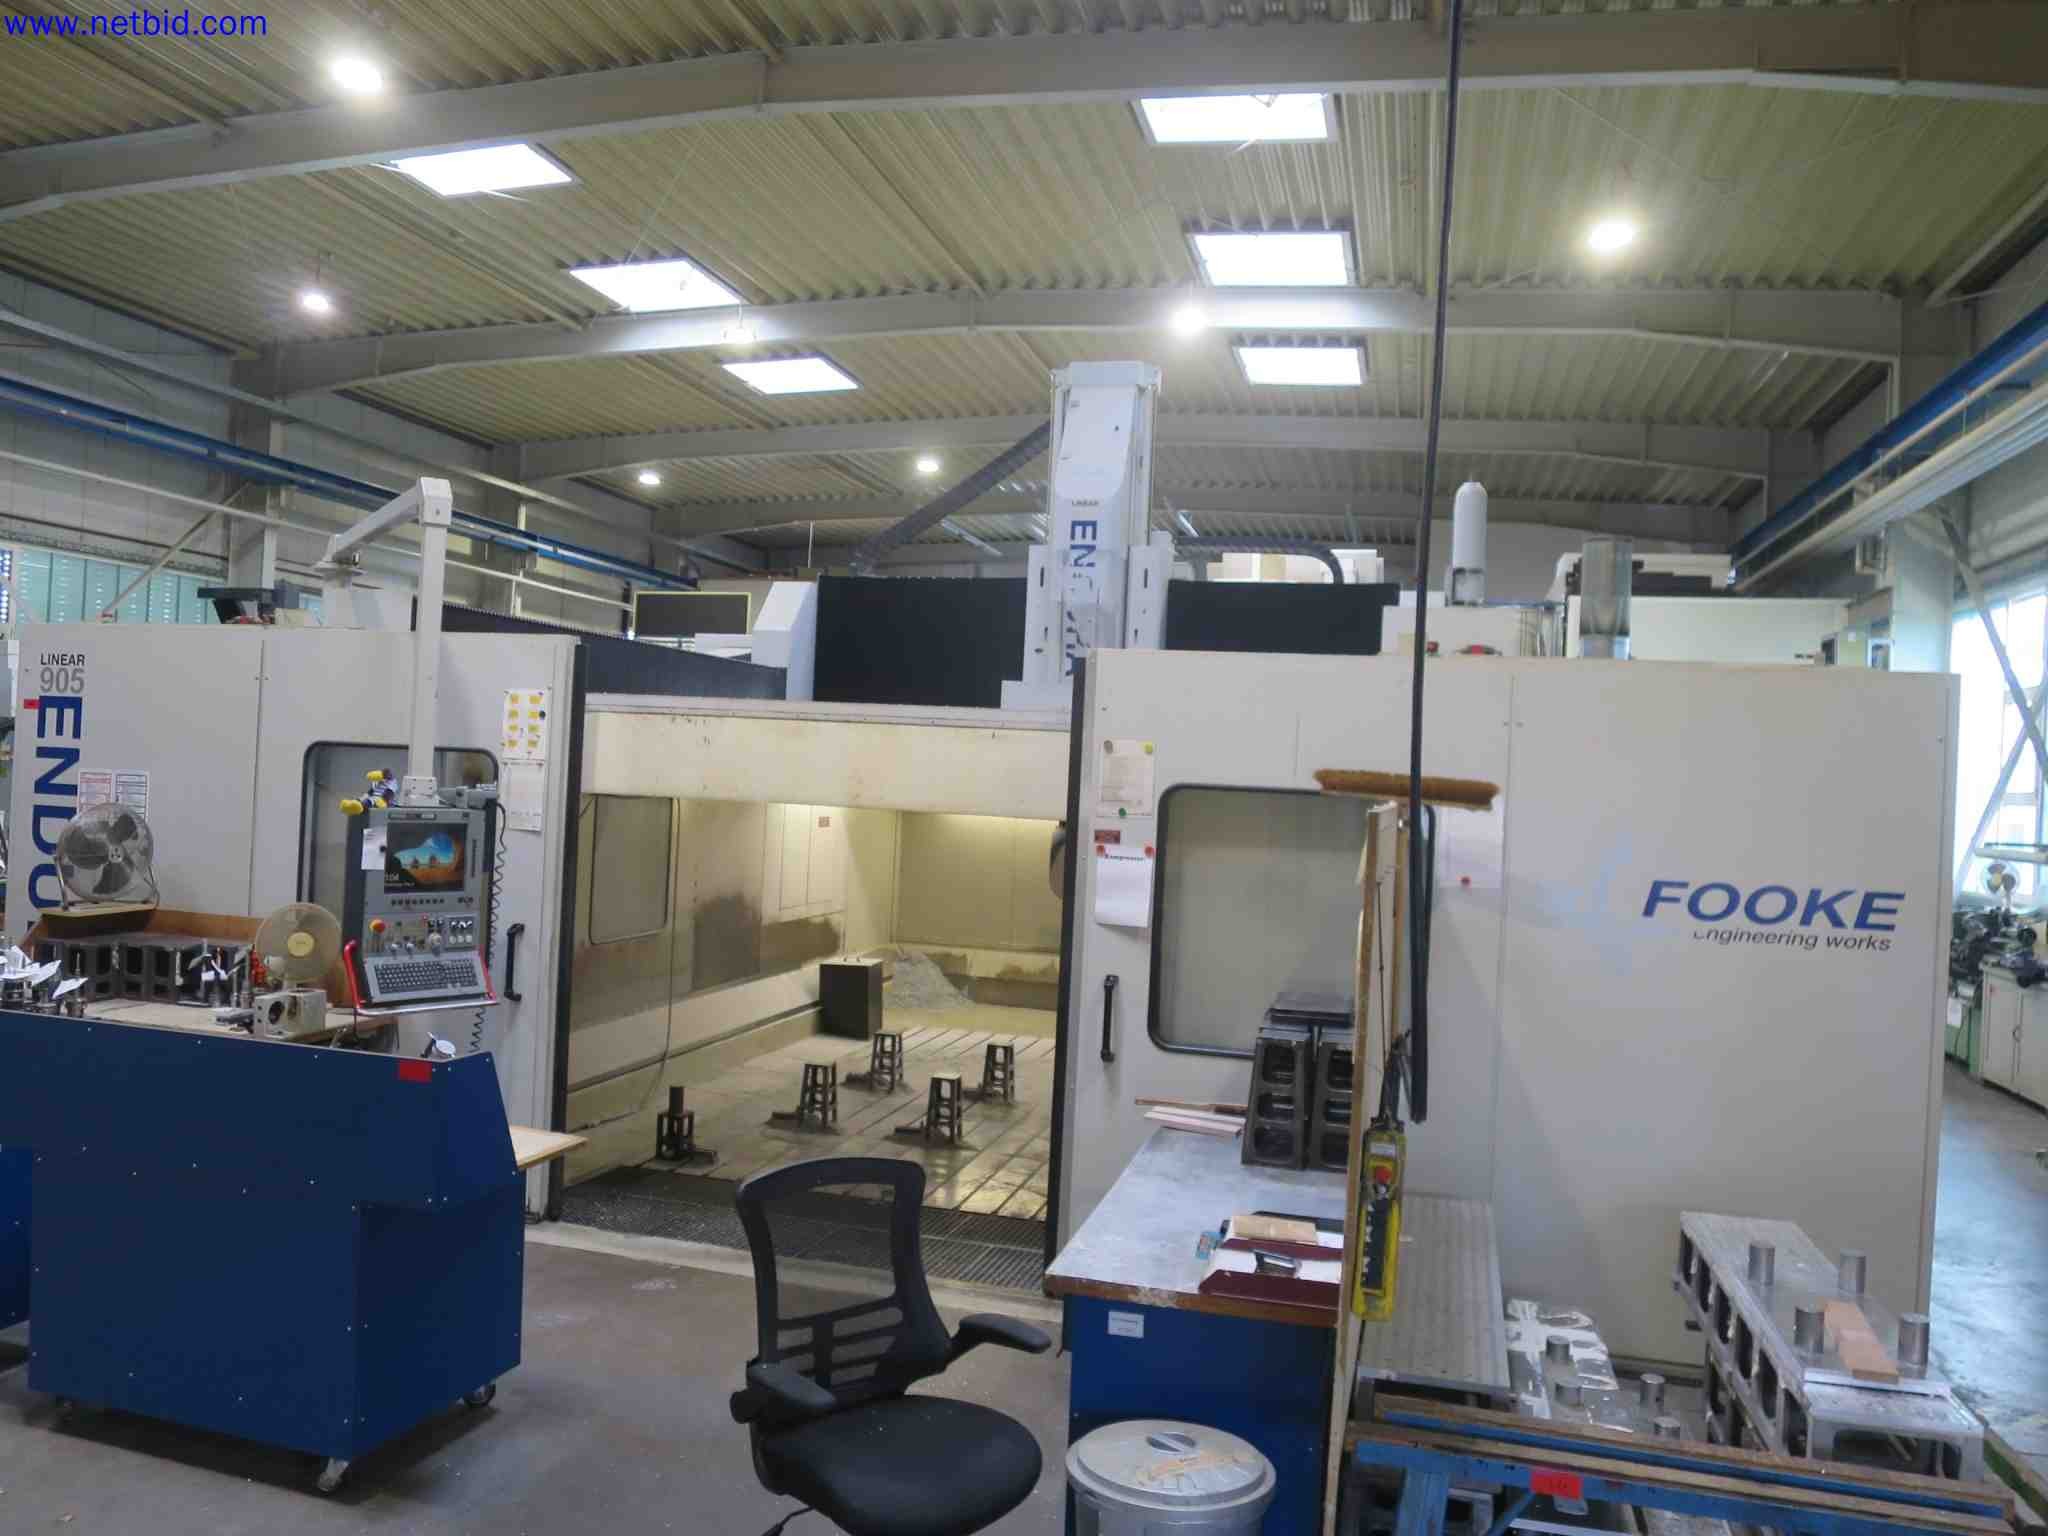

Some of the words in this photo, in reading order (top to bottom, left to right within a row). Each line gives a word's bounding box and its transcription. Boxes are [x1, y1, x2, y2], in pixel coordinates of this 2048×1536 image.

[40, 653, 85, 666] LINEAR
[39, 668, 85, 693] 905
[1641, 880, 1906, 931] FOOKE
[1826, 934, 1892, 951] works
